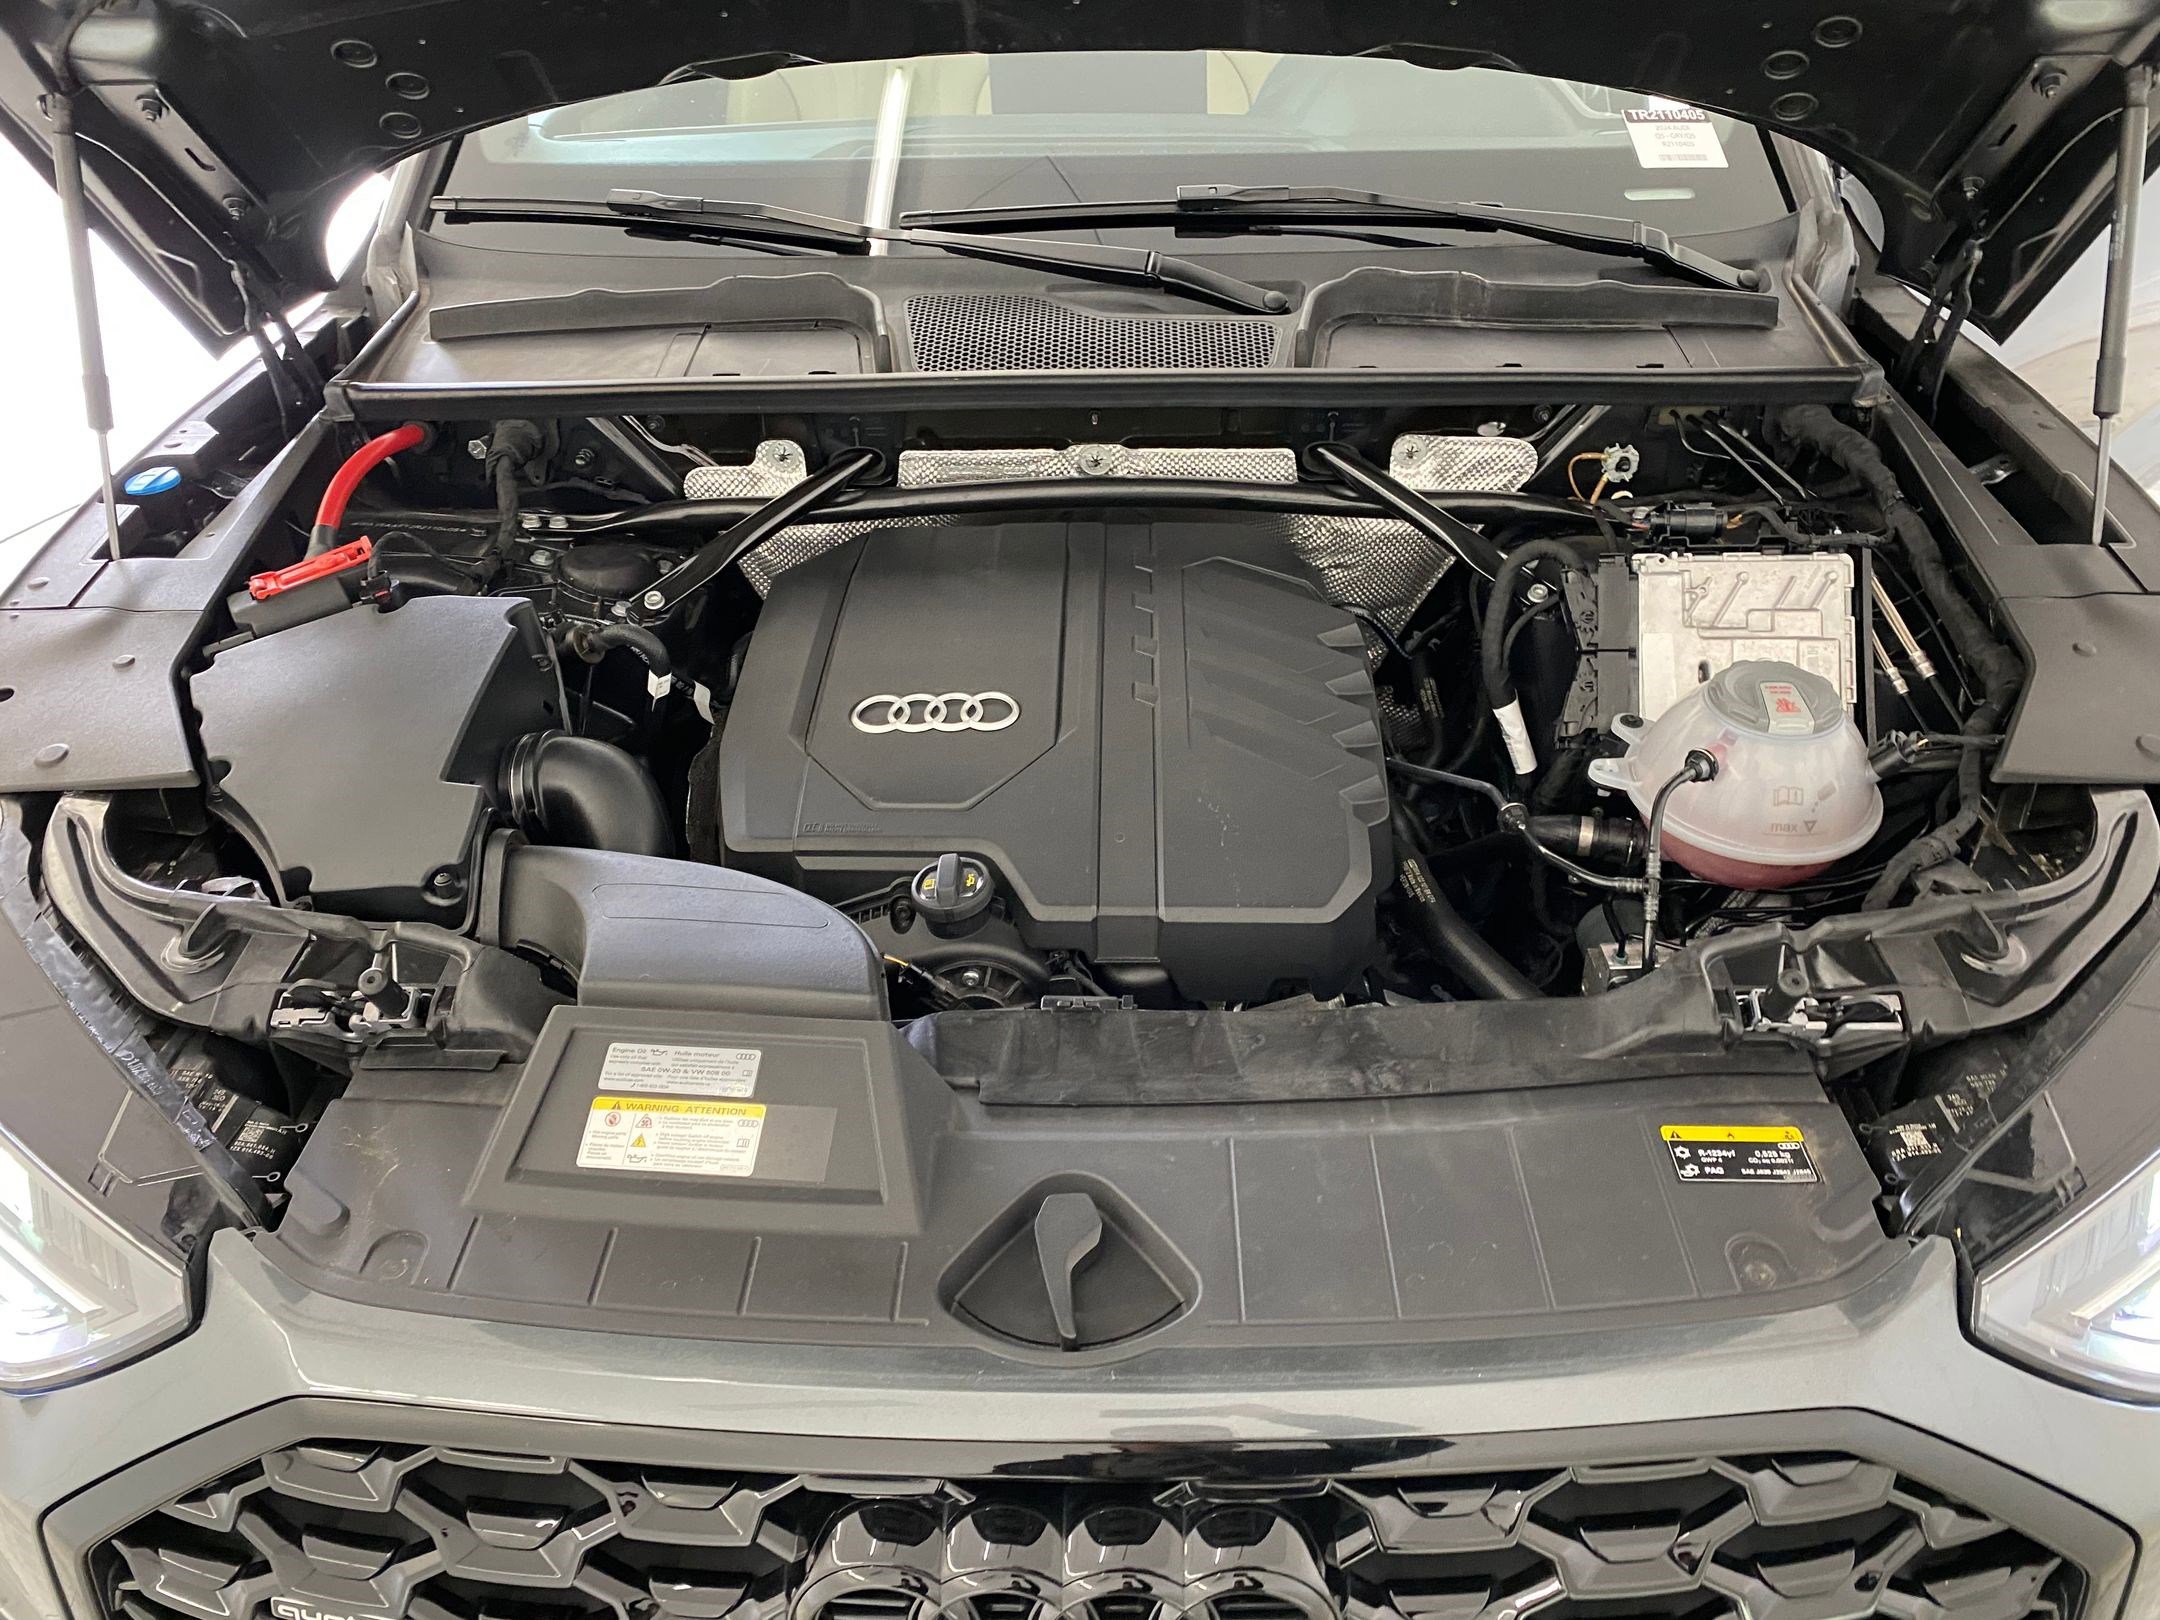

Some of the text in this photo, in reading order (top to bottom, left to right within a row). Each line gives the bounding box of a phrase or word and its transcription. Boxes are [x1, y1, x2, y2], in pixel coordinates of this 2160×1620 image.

[1628, 110, 1705, 120] TR2110405
[1771, 822, 1797, 833] max
[626, 1103, 747, 1116] WARNING ATTENTION
[1780, 1151, 1791, 1159] kg
[1704, 1167, 1725, 1175] PAG
